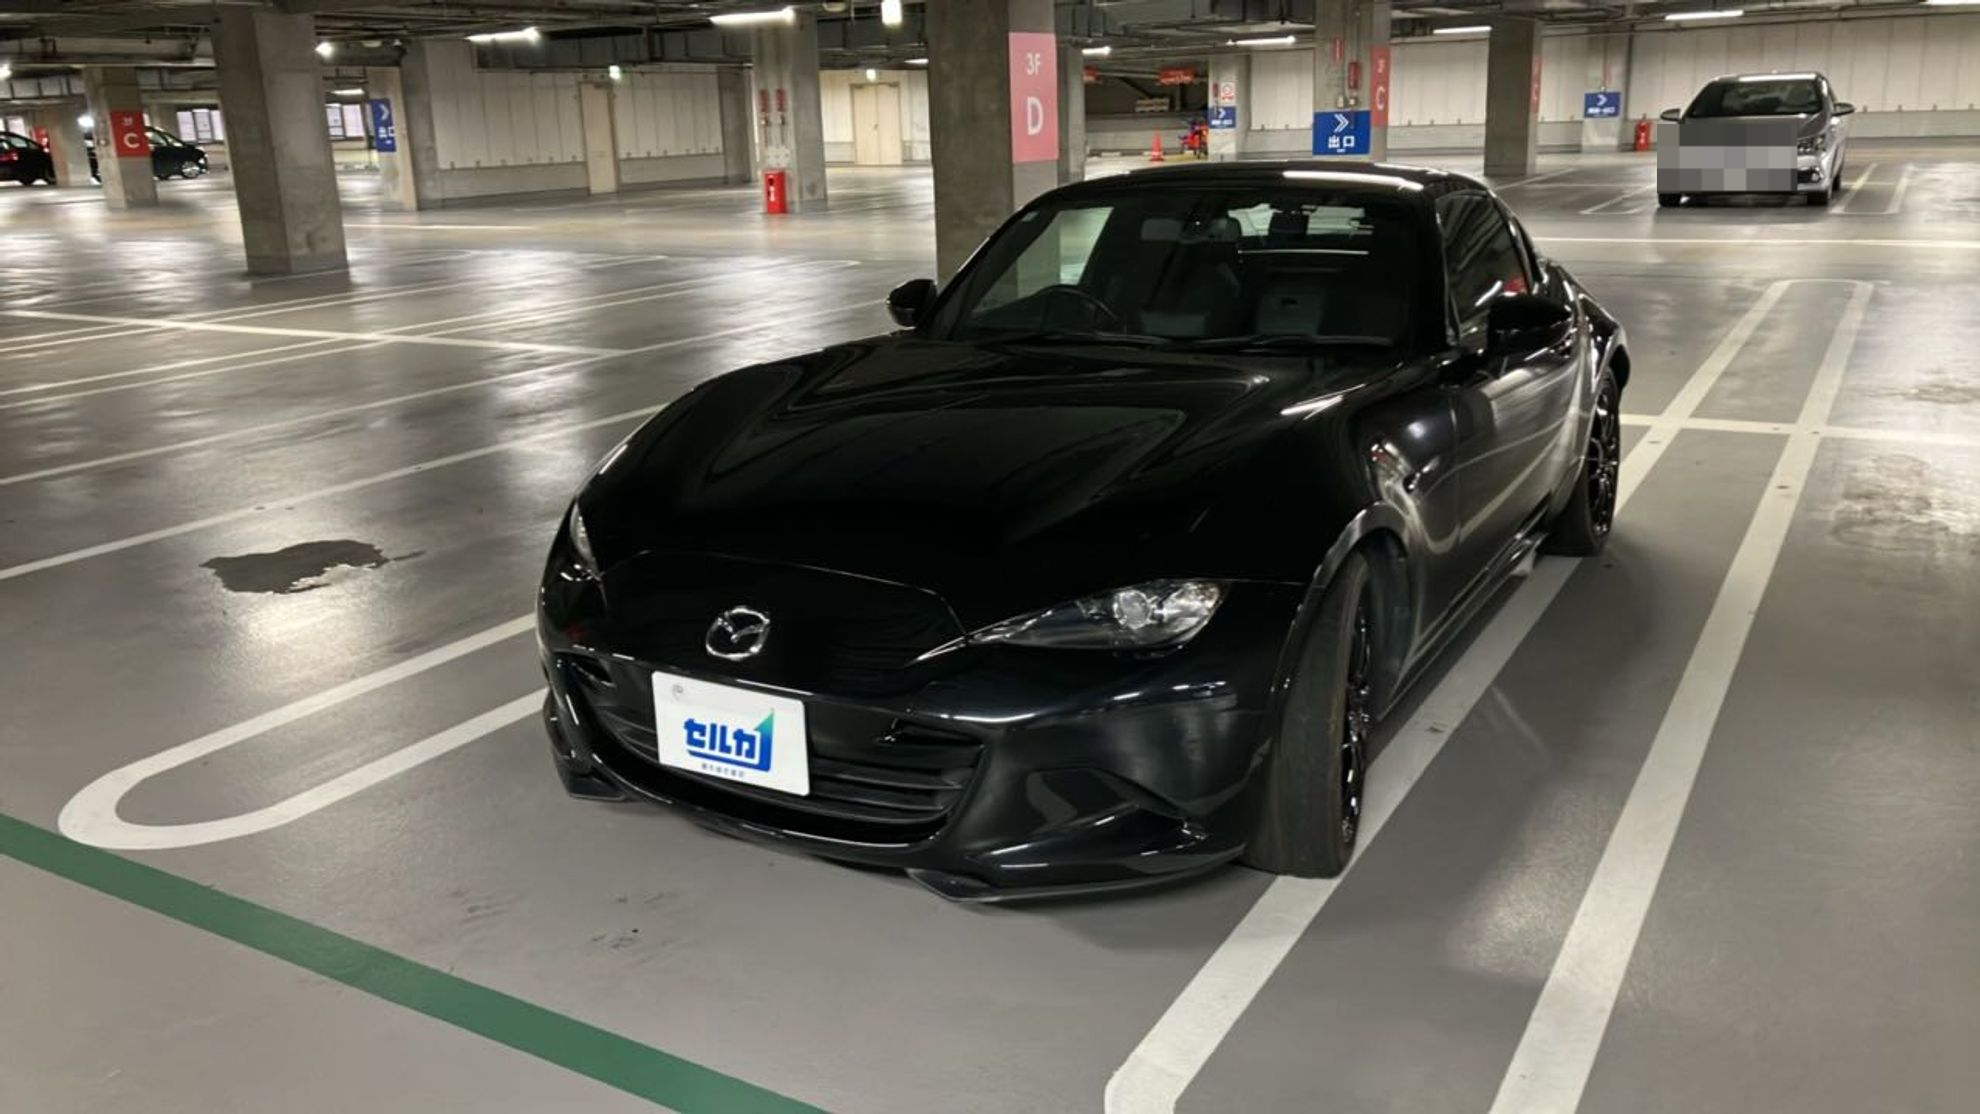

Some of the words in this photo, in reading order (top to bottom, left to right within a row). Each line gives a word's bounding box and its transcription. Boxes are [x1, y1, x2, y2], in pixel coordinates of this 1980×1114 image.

[1025, 52, 1041, 76] 3F
[1026, 96, 1044, 136] D
[123, 132, 141, 149] C
[1328, 134, 1355, 149] 出口
[683, 717, 758, 760] セルカ
